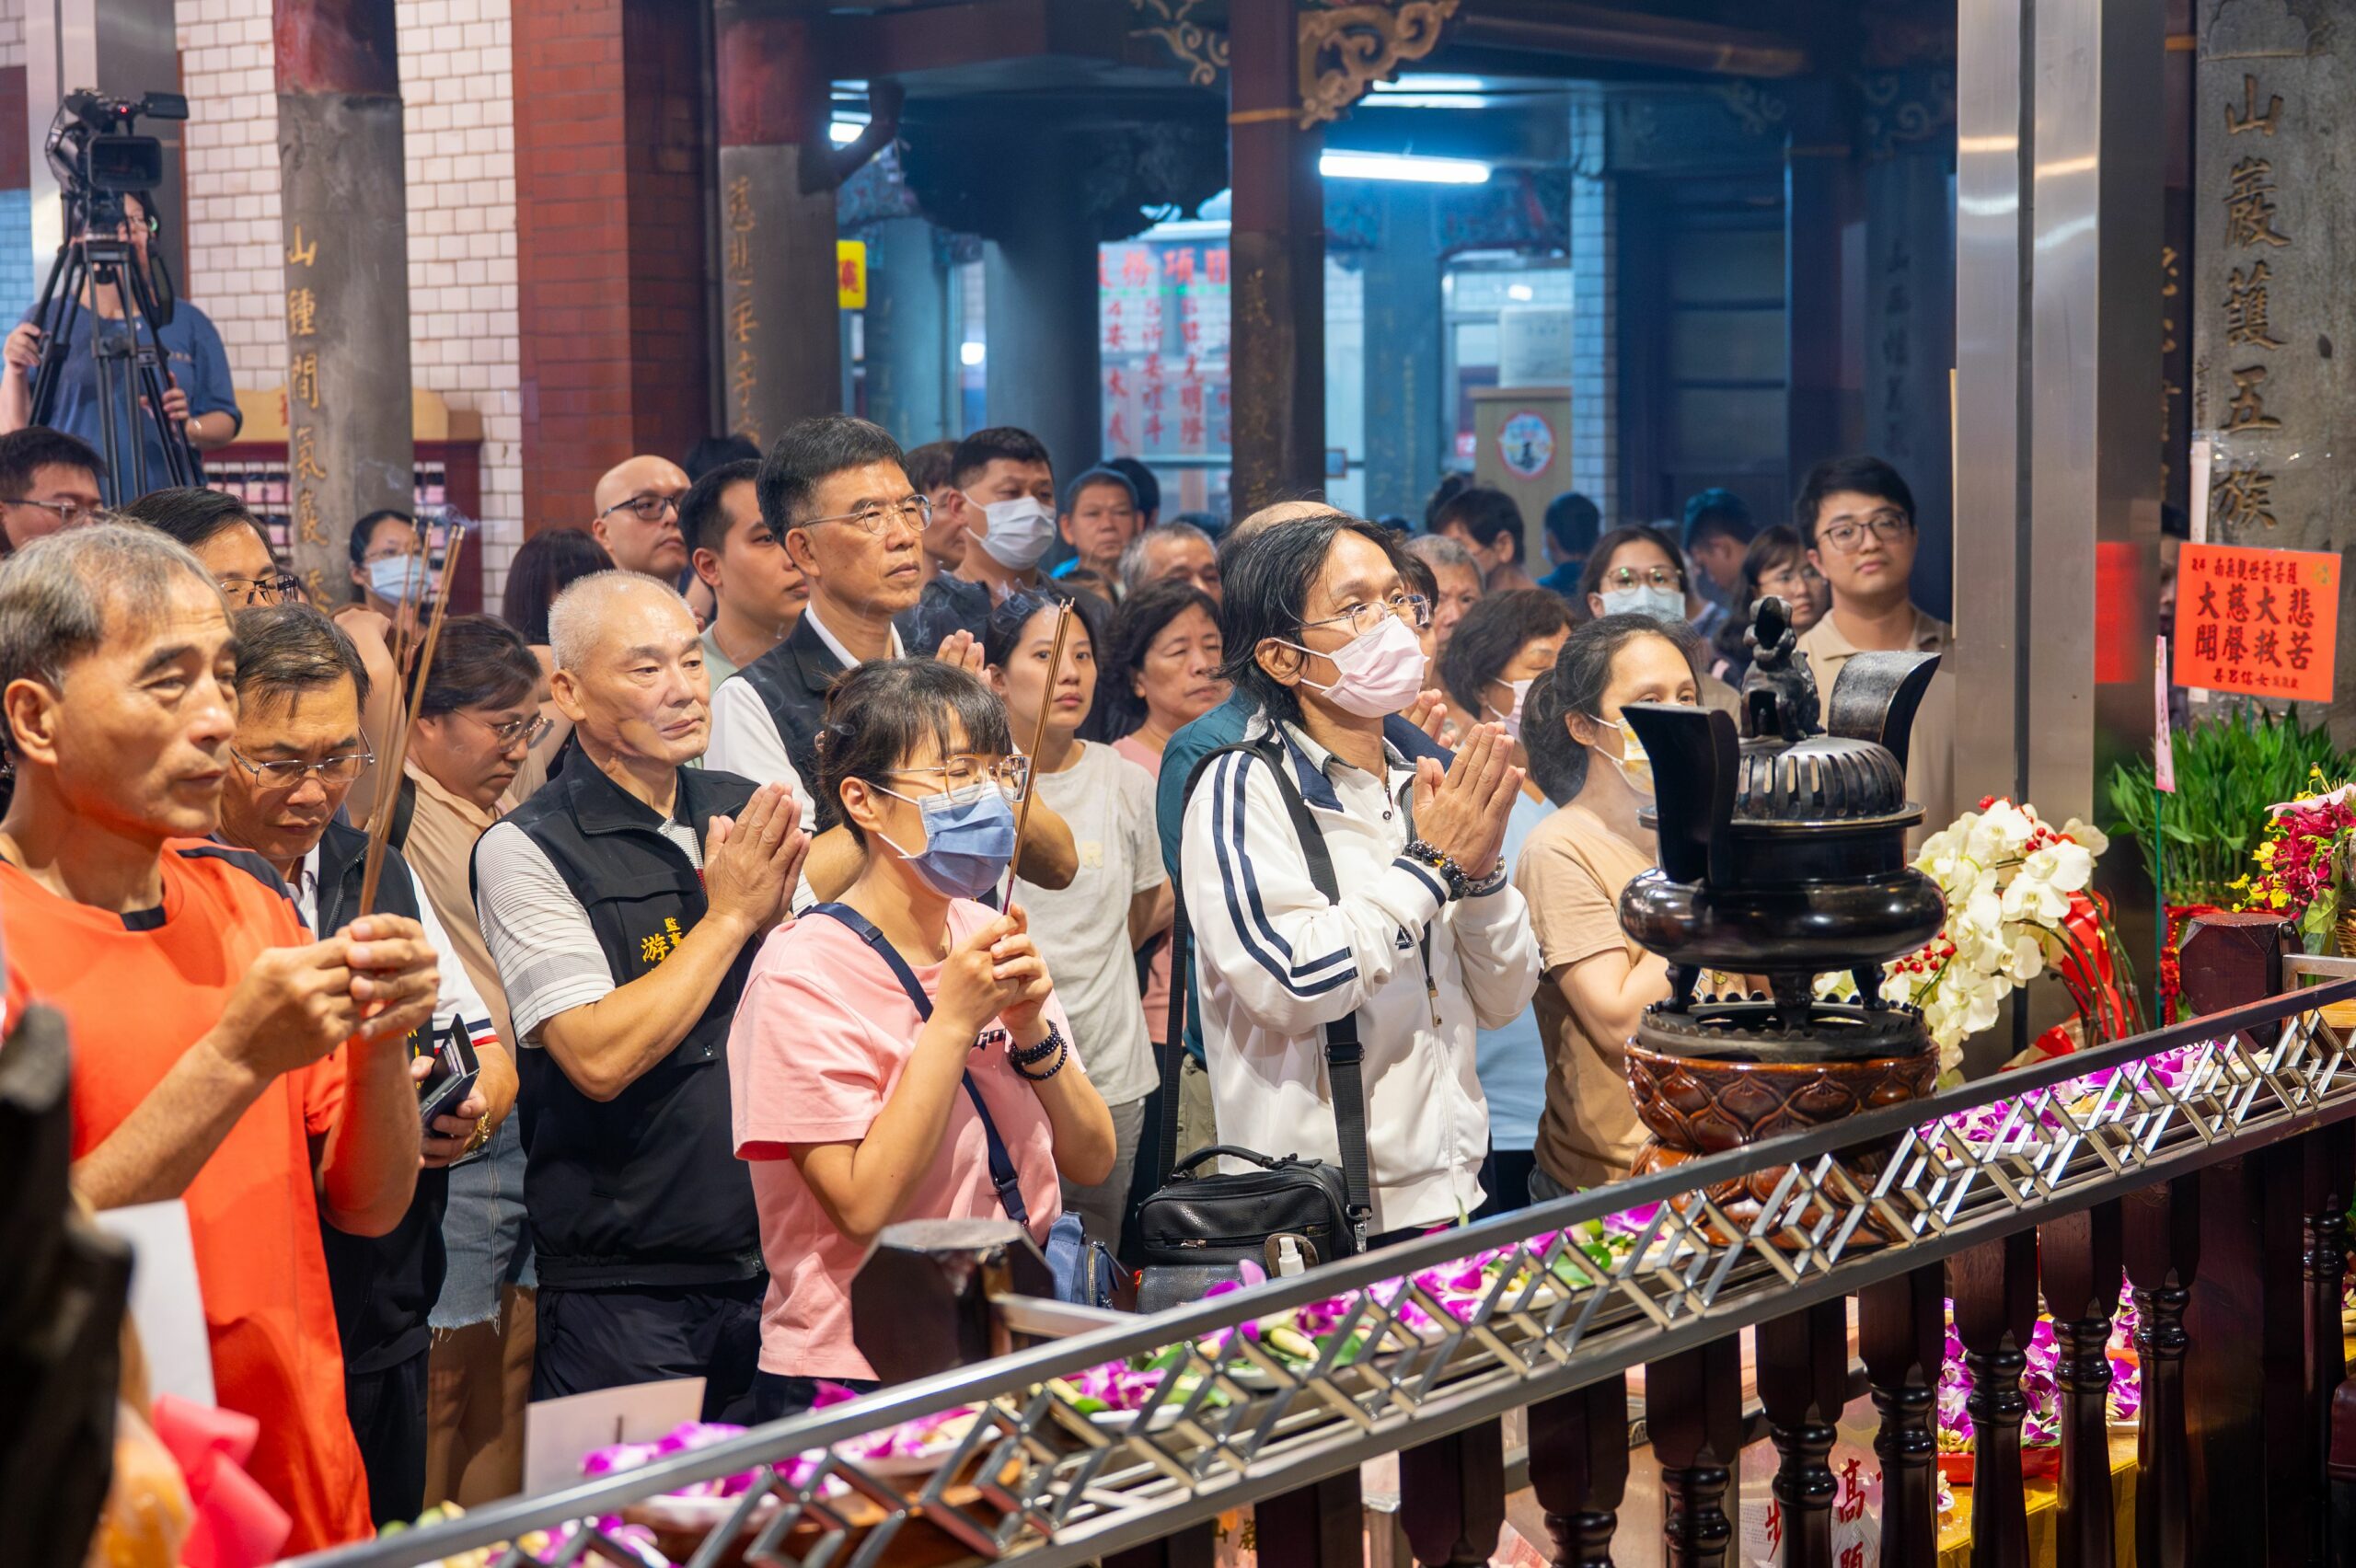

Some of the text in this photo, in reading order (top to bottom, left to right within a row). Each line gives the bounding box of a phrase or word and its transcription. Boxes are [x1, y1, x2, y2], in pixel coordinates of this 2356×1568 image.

[2197, 581, 2315, 628] 大慈大悲
[2194, 623, 2314, 671] 聞聲救苦
[641, 933, 670, 963] 游
